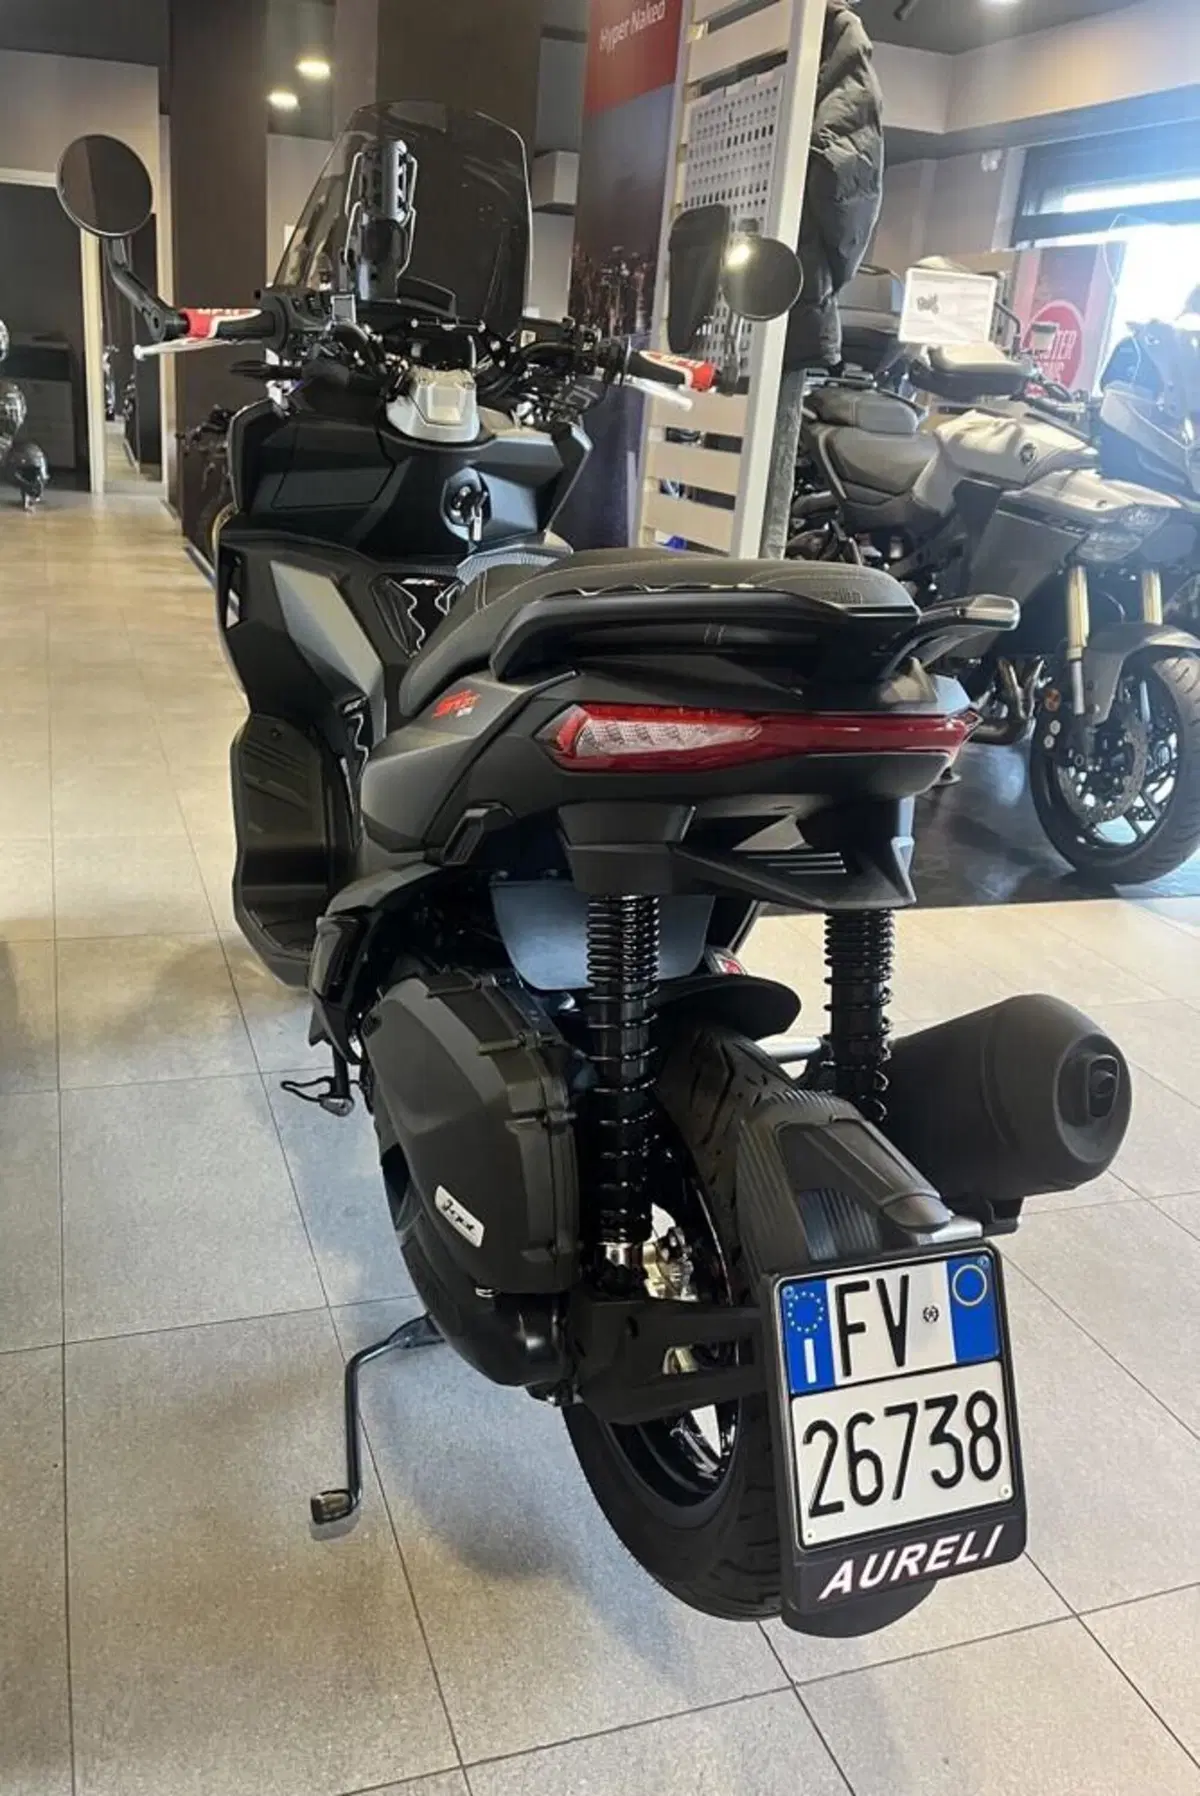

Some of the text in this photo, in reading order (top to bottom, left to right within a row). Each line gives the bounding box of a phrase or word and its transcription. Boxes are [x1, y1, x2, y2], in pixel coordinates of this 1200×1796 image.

[599, 0, 667, 54] Hyper Naked
[803, 1338, 817, 1384] I
[834, 1274, 910, 1377] FV
[802, 1390, 1003, 1519] 26738
[818, 1524, 1004, 1600] AURELI
